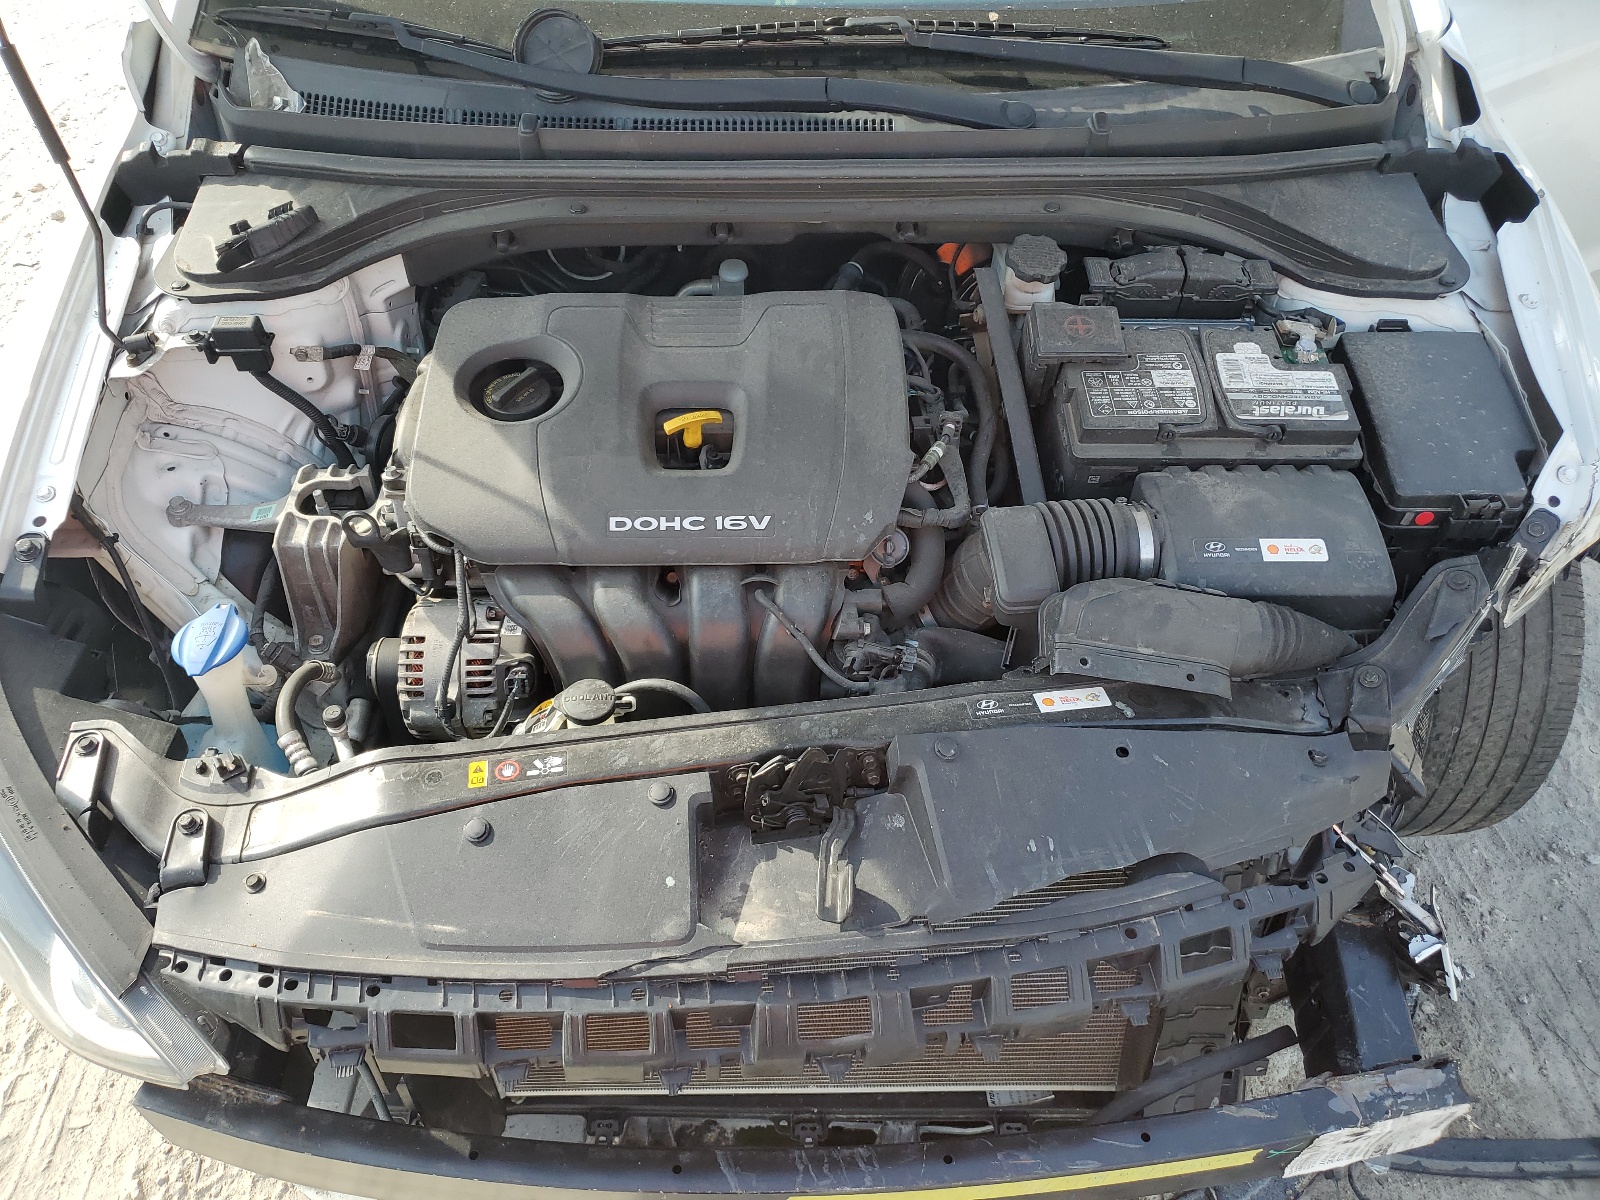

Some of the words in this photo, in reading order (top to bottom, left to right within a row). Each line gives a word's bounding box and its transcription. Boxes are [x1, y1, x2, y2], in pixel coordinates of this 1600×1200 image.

[1252, 405, 1325, 417] Duralast
[609, 516, 706, 532] DOHC
[715, 515, 772, 531] 16V
[564, 691, 616, 703] COOLANT
[976, 708, 1005, 716] HYUNDAI
